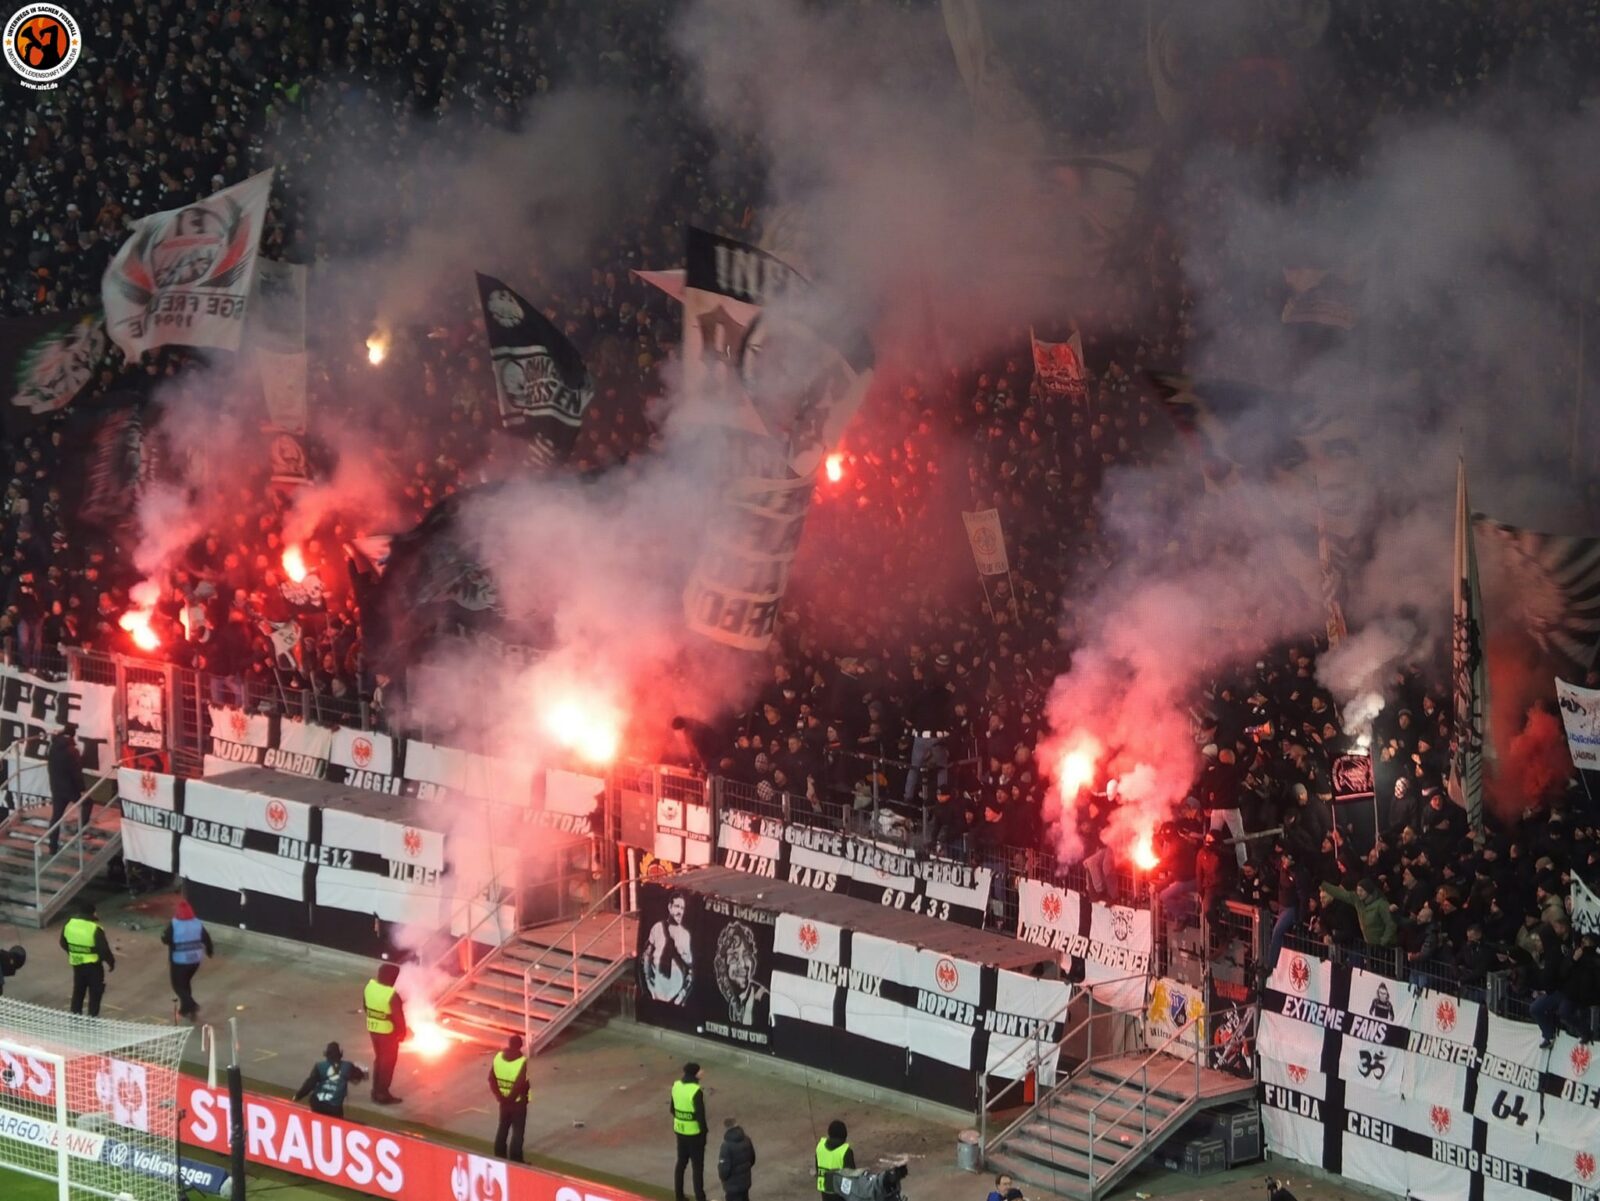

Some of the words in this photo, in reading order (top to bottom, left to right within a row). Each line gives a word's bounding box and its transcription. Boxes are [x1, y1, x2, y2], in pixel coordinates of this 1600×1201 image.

[0, 675, 82, 725] PPE
[0, 718, 107, 771] RBT
[213, 738, 258, 764] NUOVA
[344, 768, 401, 796] JAGGER
[122, 800, 186, 834] WINNETOU
[724, 849, 777, 880] ULTRA
[1051, 929, 1089, 959] NEVER
[806, 959, 883, 998] NACHWUX
[1282, 995, 1346, 1031] EXTREME
[1349, 1013, 1388, 1043] FANS
[1264, 1084, 1322, 1120] FULDA
[1491, 1089, 1529, 1126] 64
[1347, 1111, 1394, 1145] CREW
[133, 1150, 213, 1187] Volkswagen
